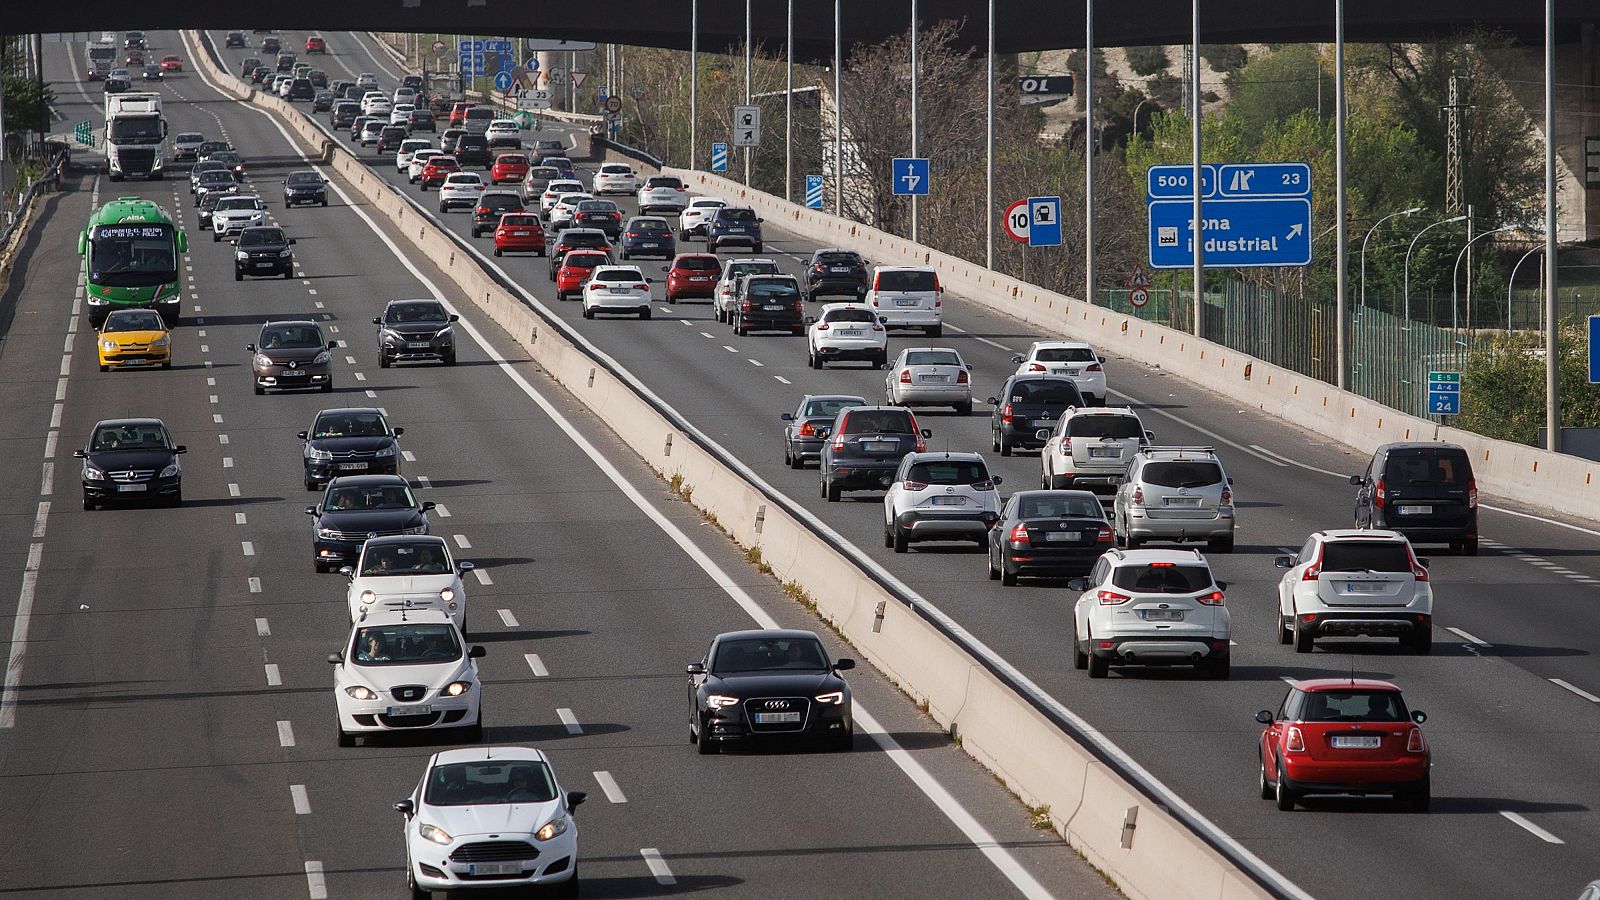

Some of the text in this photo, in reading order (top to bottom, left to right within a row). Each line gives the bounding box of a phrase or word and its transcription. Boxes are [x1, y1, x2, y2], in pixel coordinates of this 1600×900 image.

[1158, 175, 1188, 187] 500
[1282, 173, 1301, 185] 23
[1011, 213, 1029, 229] 10
[1188, 236, 1278, 252] idustrial
[1436, 402, 1452, 411] 24
